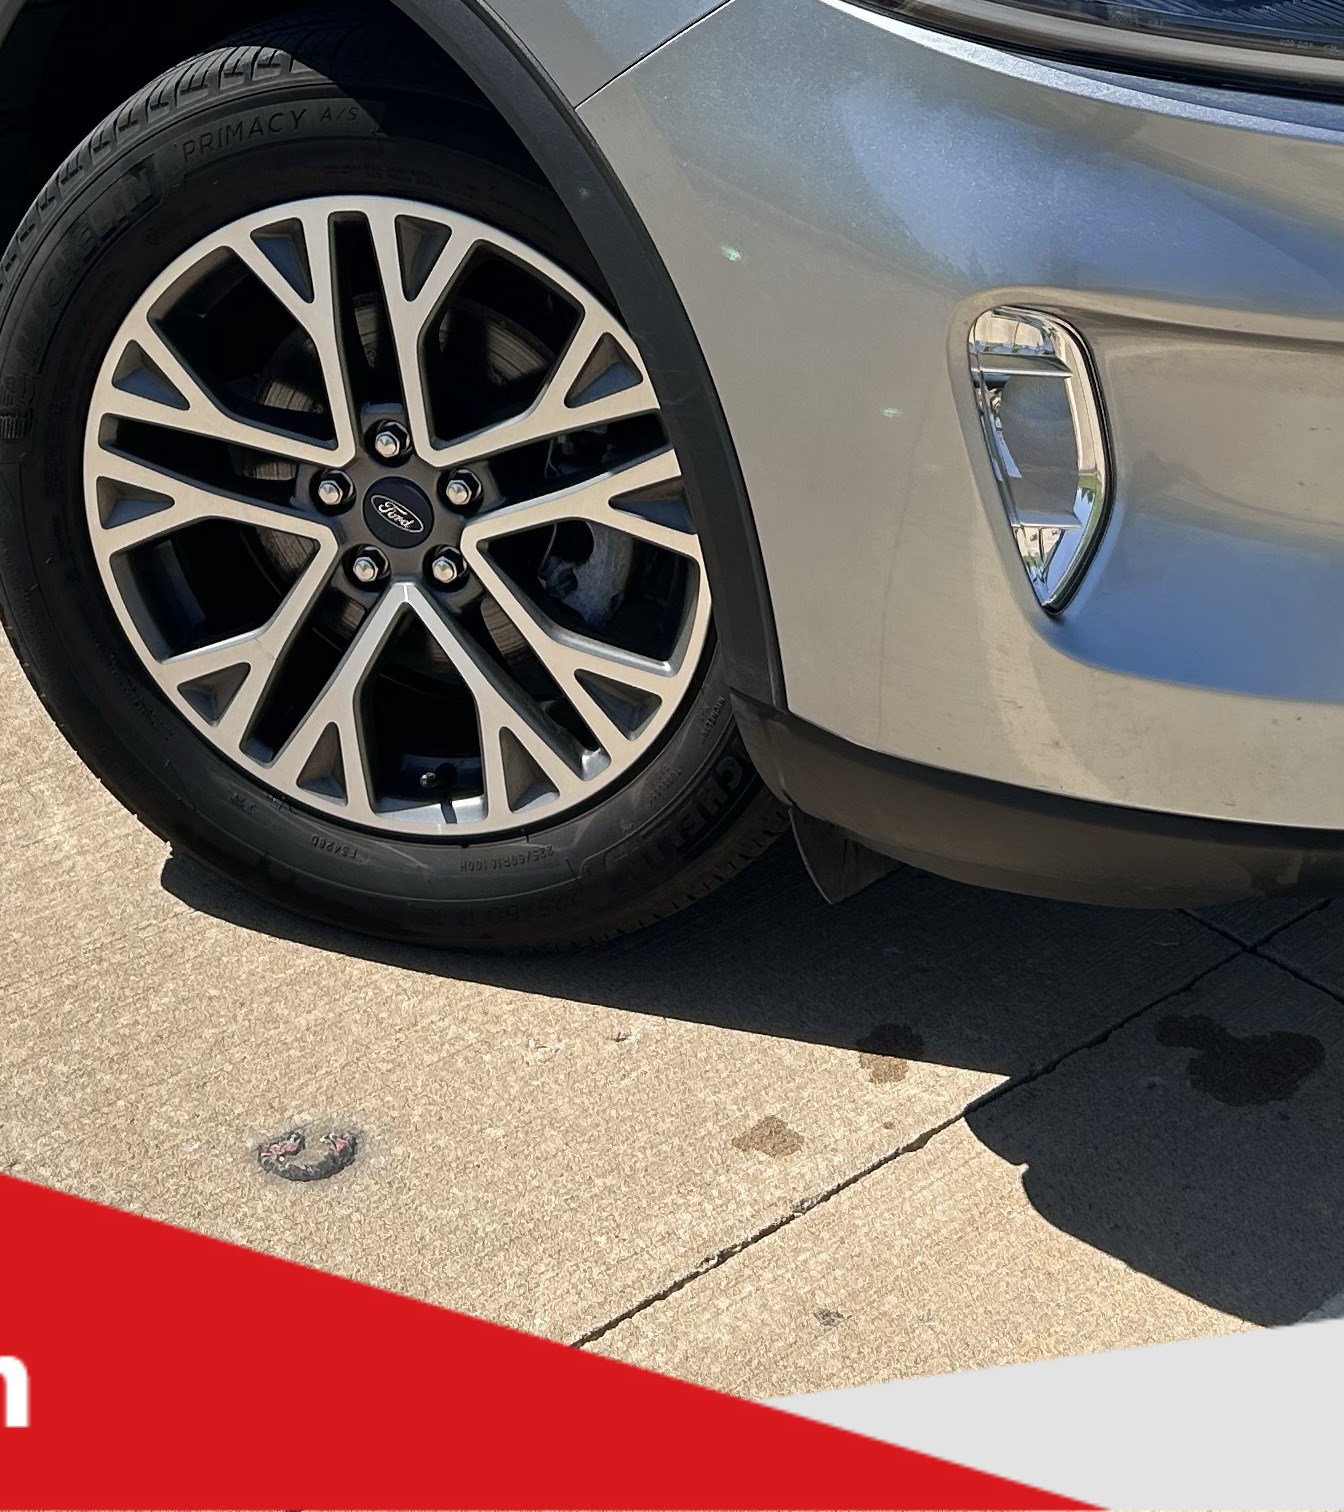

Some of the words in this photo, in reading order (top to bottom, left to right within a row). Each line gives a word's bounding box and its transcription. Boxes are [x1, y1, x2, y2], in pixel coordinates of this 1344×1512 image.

[183, 107, 308, 164] PRIMACY
[319, 105, 358, 123] A/S
[378, 501, 415, 528] Ford
